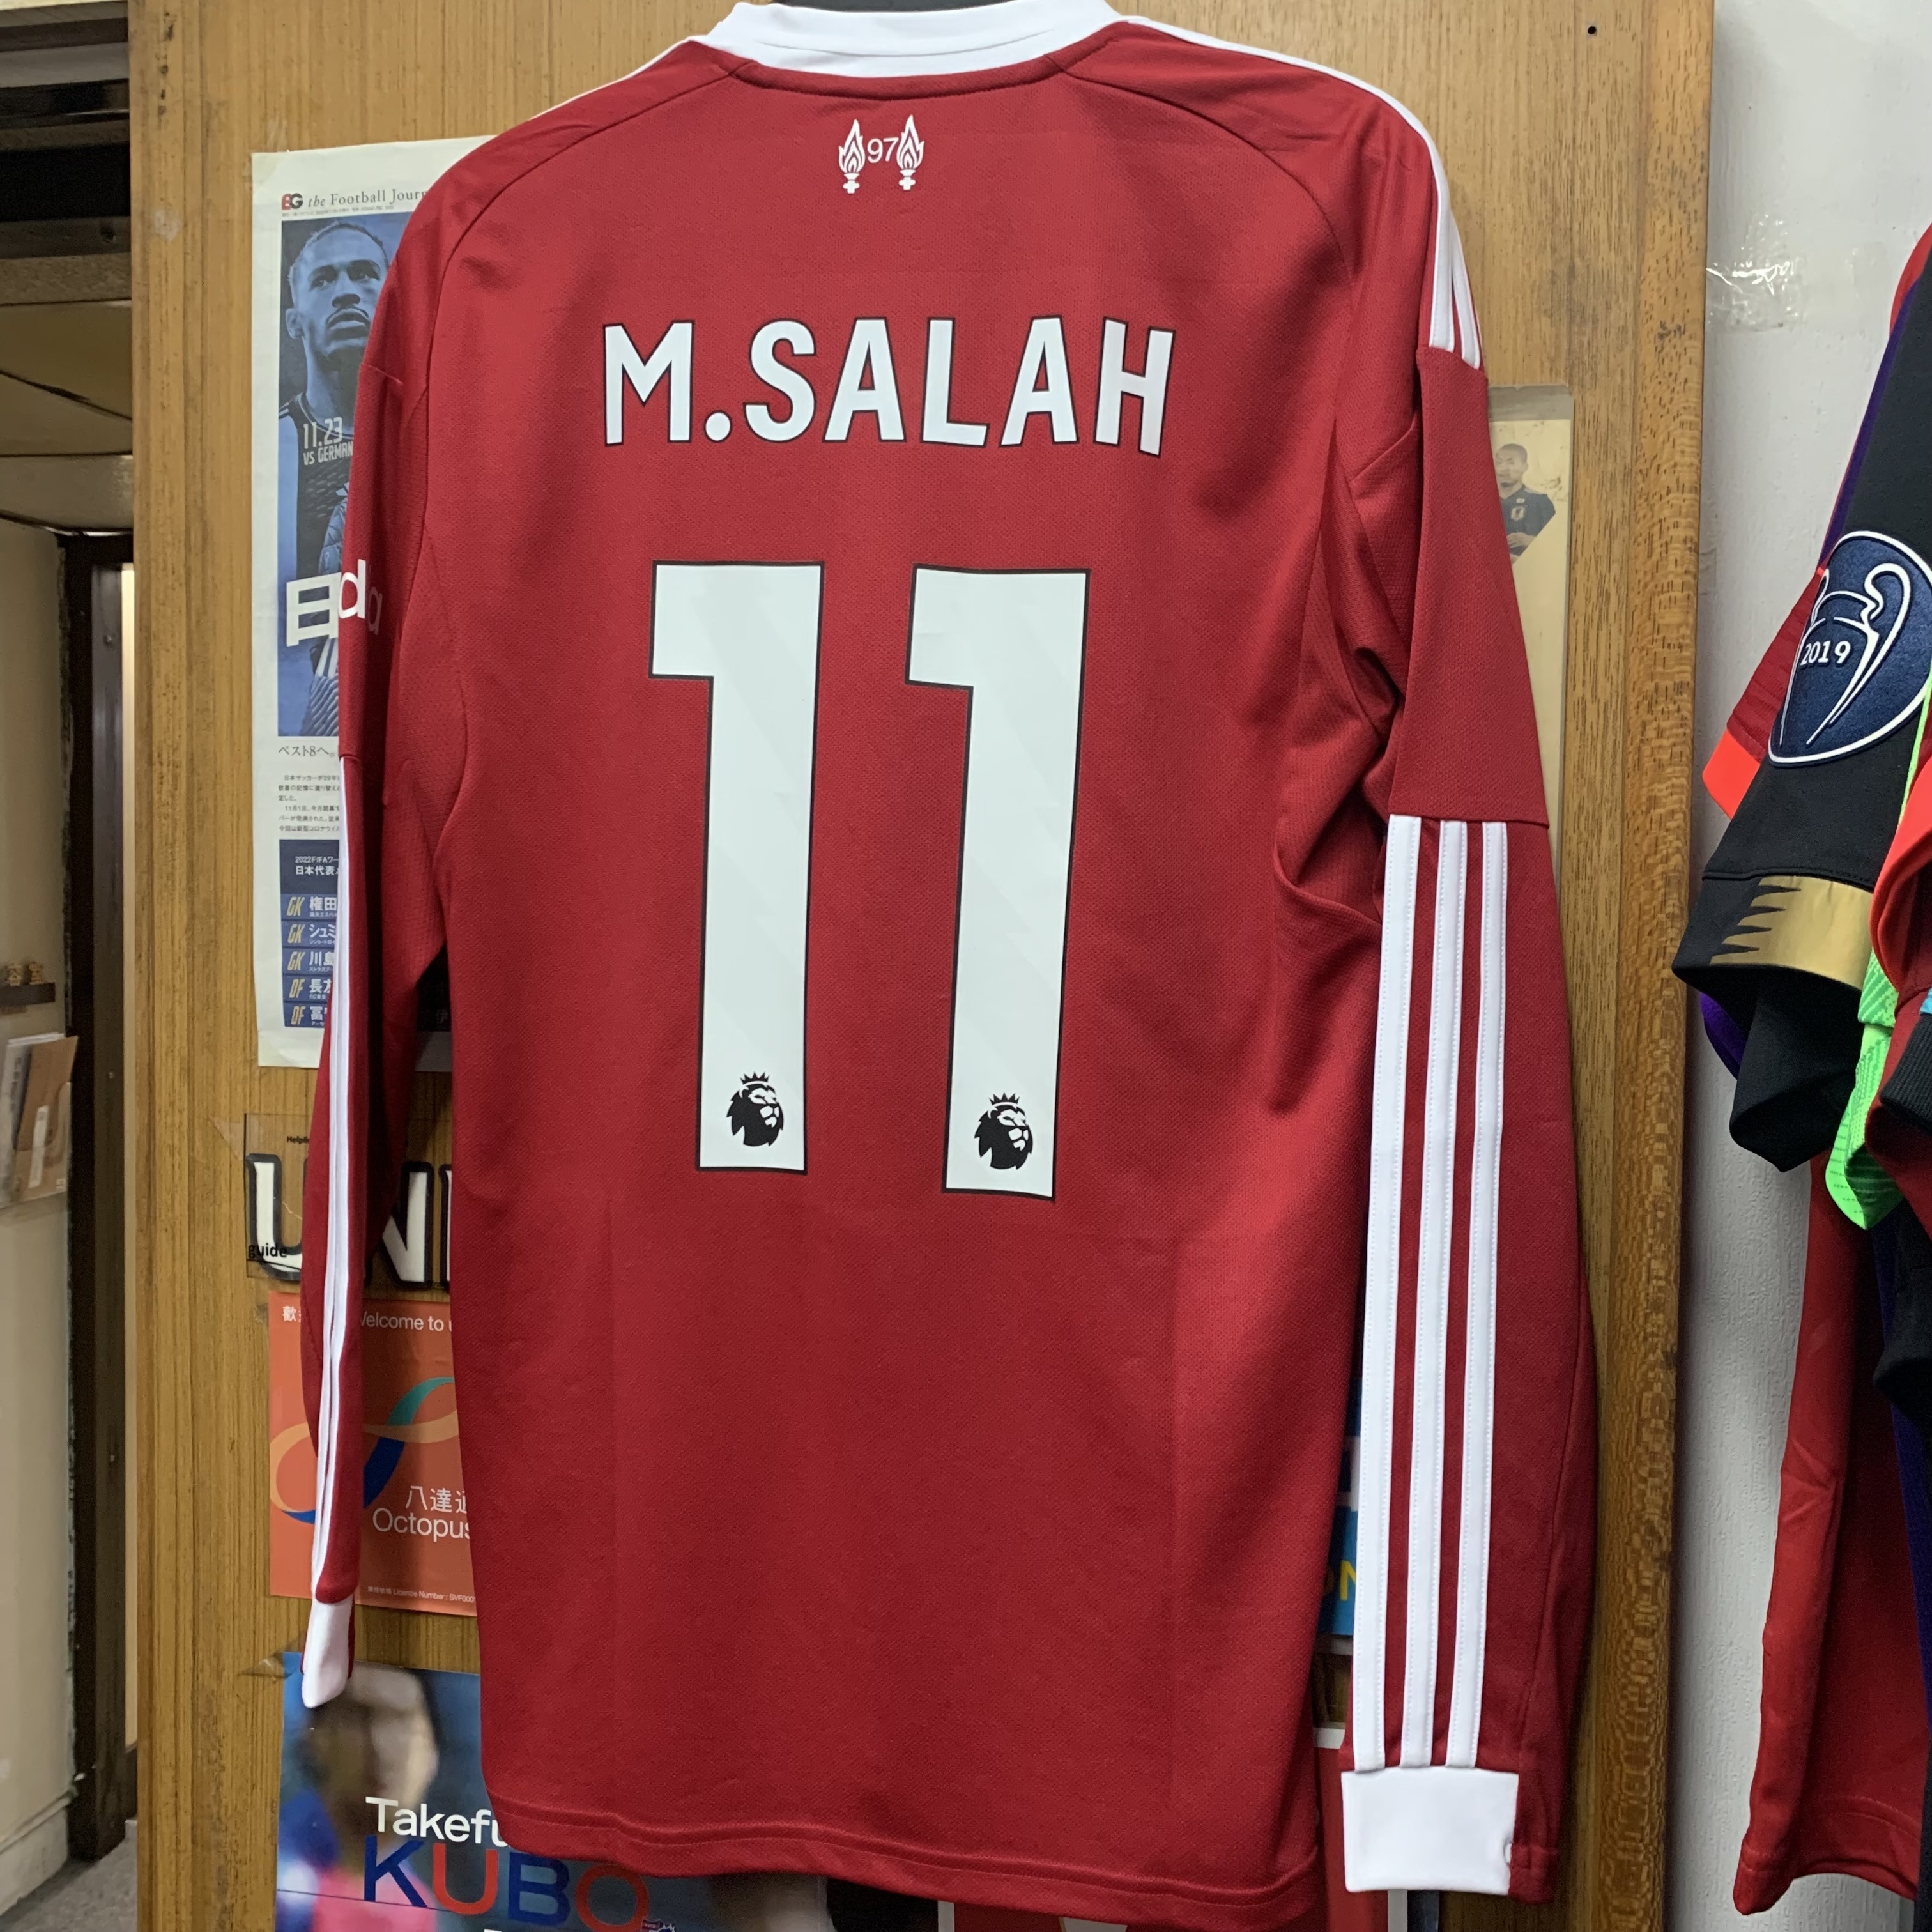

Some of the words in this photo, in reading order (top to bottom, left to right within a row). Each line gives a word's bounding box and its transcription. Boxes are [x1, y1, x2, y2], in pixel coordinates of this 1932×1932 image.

[866, 137, 899, 164] 97
[308, 194, 326, 208] the
[330, 189, 386, 206] Football
[603, 315, 1176, 458] M.SALAH
[302, 416, 343, 450] 11.23
[303, 450, 316, 466] VS
[1800, 640, 1851, 667] 2019
[279, 745, 335, 758] ベスト8へ。
[648, 560, 1091, 1201] 11
[286, 896, 305, 916] GK
[288, 924, 306, 943] GK
[287, 951, 306, 970] GK
[310, 1006, 327, 1020] 富
[248, 1243, 288, 1259] guide
[282, 1305, 302, 1322] 歡
[361, 1311, 424, 1330] elcome
[427, 1315, 445, 1331] to
[418, 1591, 445, 1600] Number
[364, 1834, 650, 1932] KUBO
